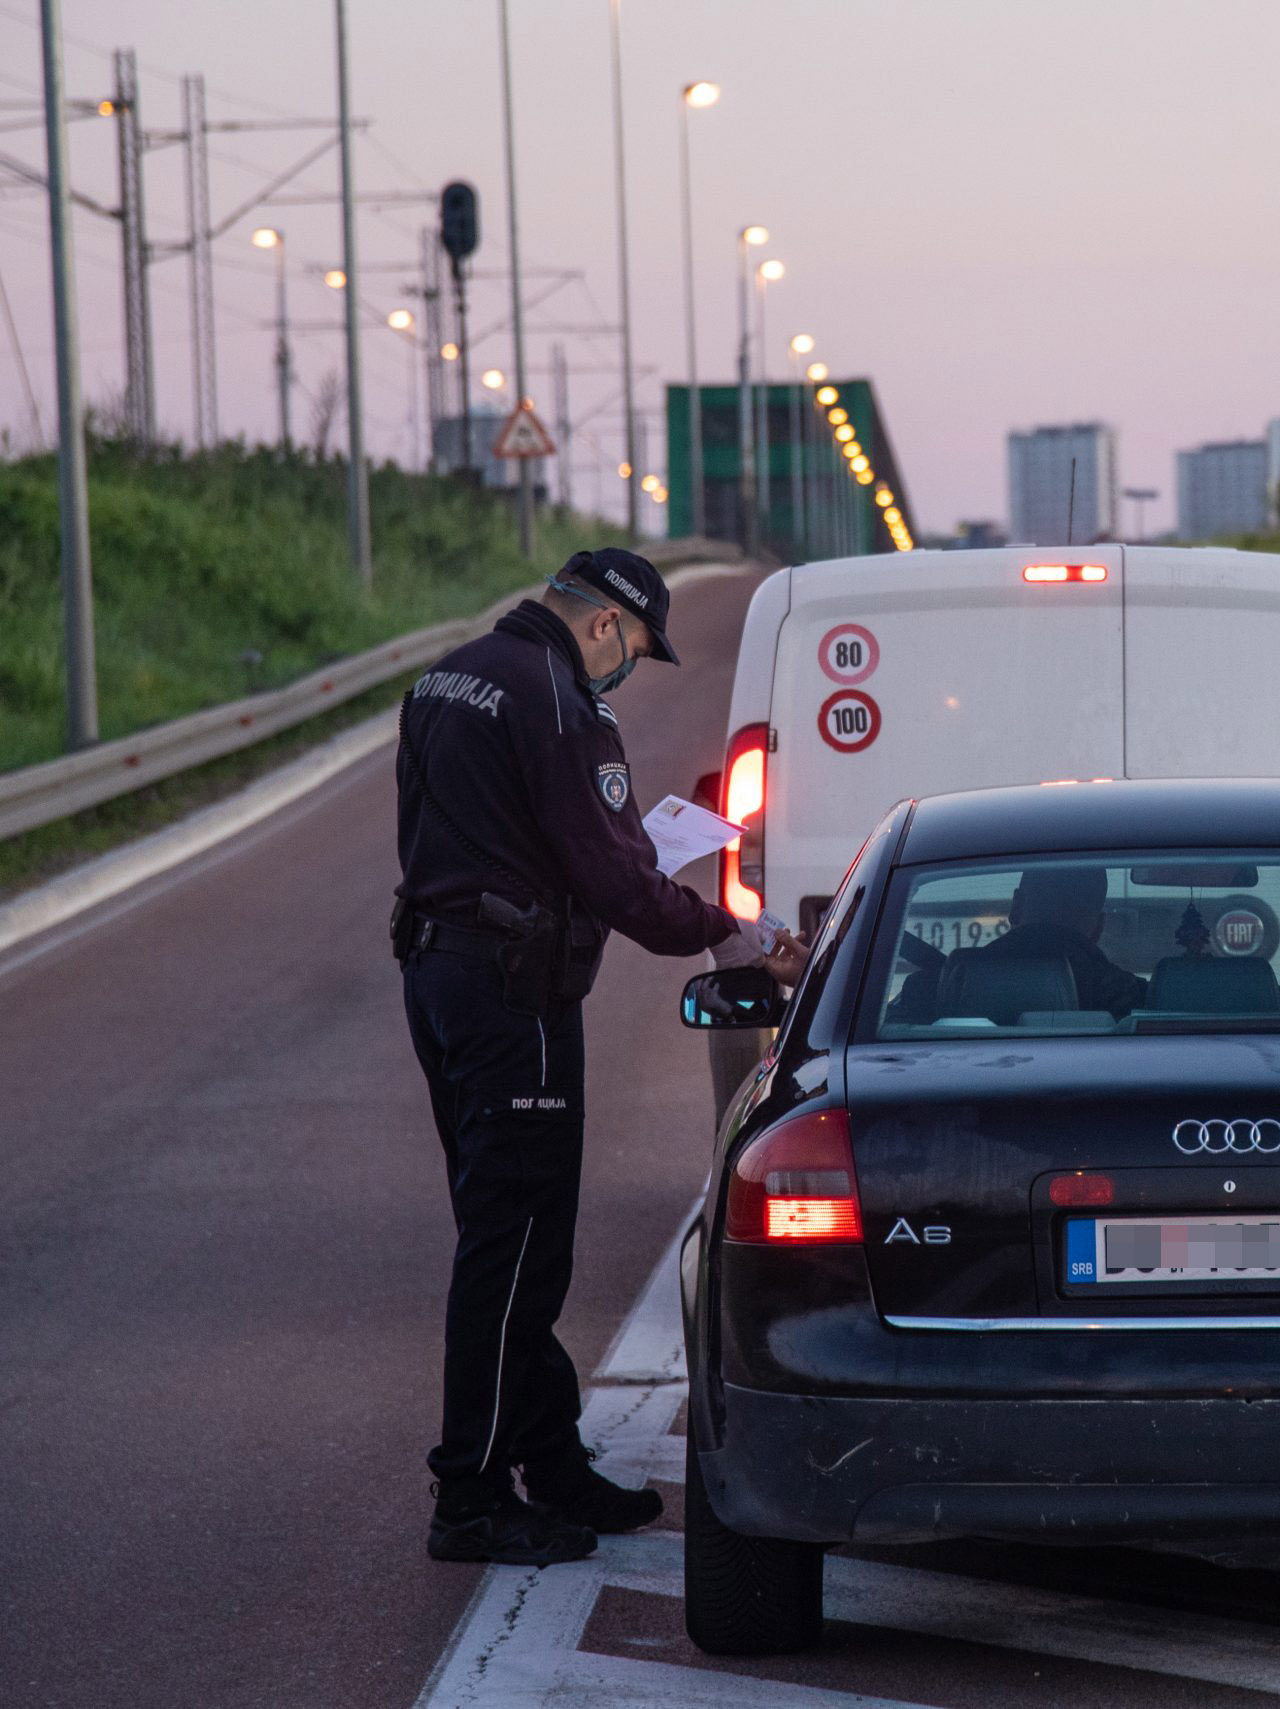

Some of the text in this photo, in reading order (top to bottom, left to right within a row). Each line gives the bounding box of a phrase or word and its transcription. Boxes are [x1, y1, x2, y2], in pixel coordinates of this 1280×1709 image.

[604, 568, 649, 609] ПОЛИЦИЈА
[835, 641, 862, 668] 80
[413, 671, 504, 718] ОЛИЦИЈА
[832, 706, 868, 735] 100
[1226, 923, 1254, 944] FIAT
[884, 1217, 952, 1245] A6
[1071, 1262, 1093, 1275] SRB
